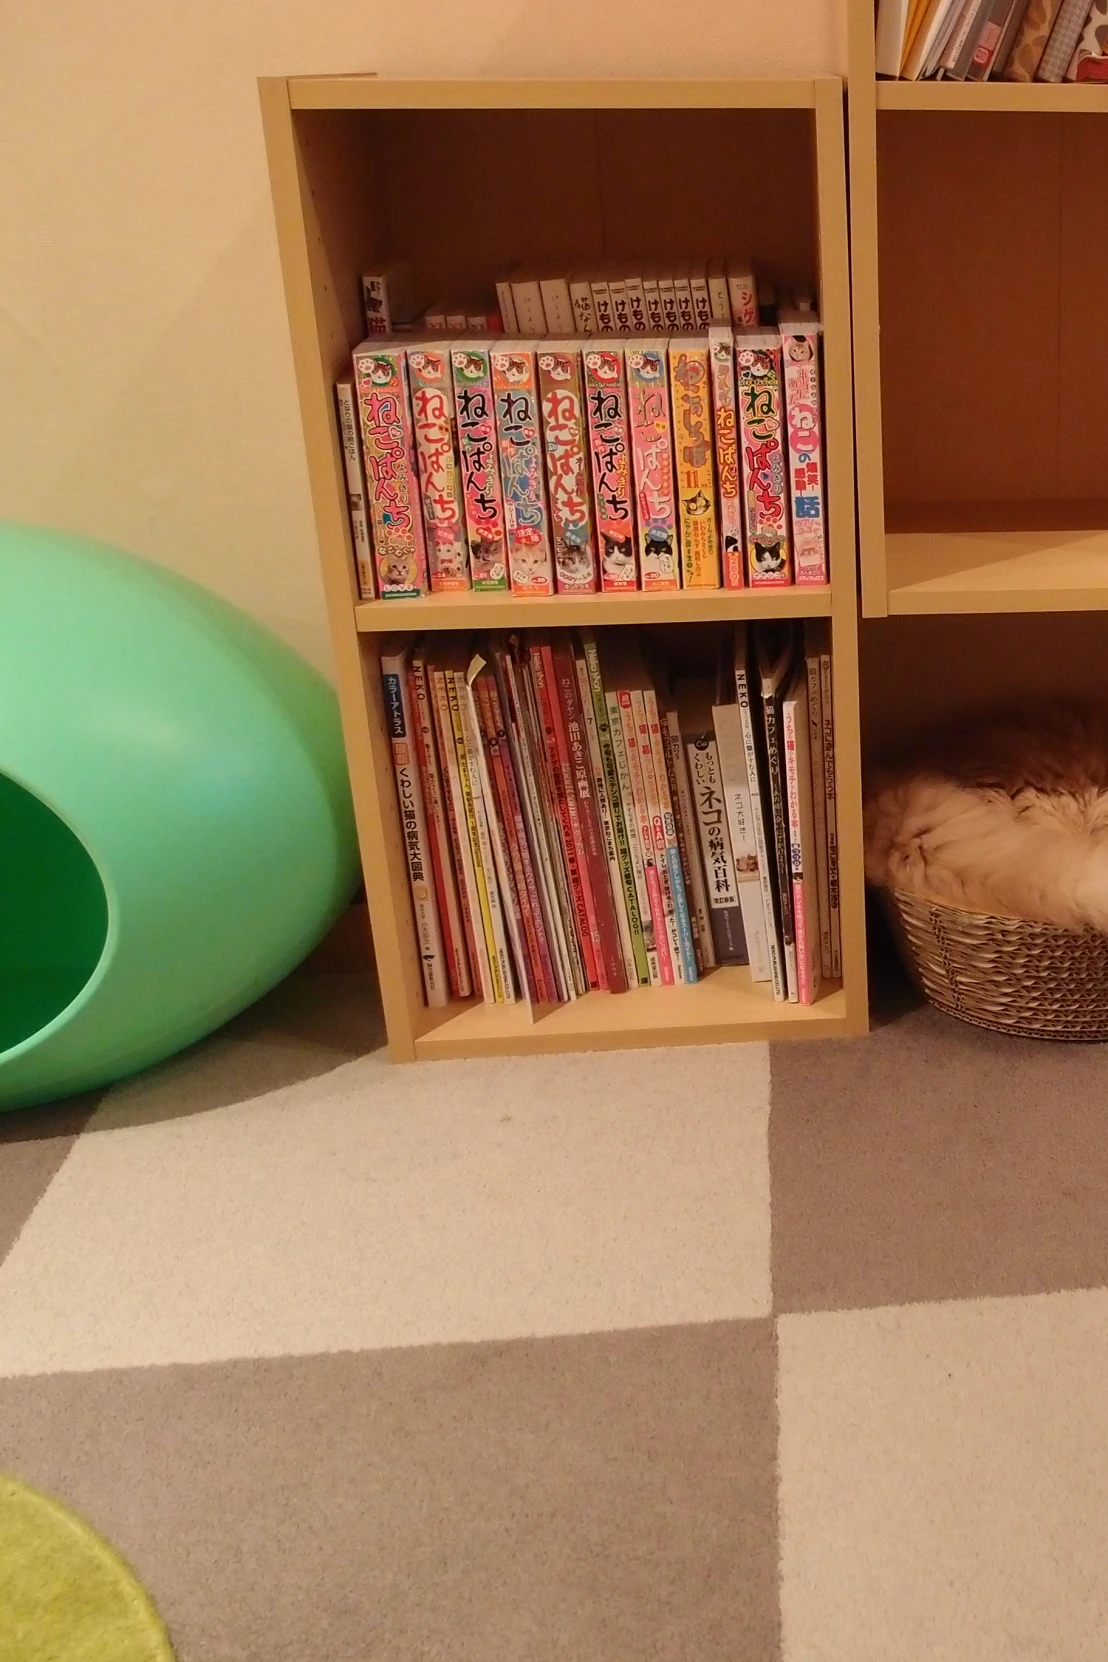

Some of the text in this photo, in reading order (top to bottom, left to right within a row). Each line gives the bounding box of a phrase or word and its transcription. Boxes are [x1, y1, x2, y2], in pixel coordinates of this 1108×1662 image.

[364, 392, 412, 530] ねこぱんち
[414, 389, 459, 524] ねこぱんち
[456, 389, 497, 520] ねこぱんち
[500, 392, 543, 526] ねこぱんち
[546, 390, 587, 524] ねこぱんち
[590, 390, 629, 521] ねこぱんち
[634, 389, 672, 519] ねこぱんち
[744, 386, 782, 520] ねこぱんち
[792, 407, 817, 452] ねこ
[794, 496, 820, 519] 話
[413, 665, 426, 701] NEKO
[436, 677, 448, 712] NEKO
[447, 677, 459, 712] NEKO
[588, 649, 598, 673] Neko
[736, 673, 749, 708] NEKO
[387, 676, 404, 734] カラーアトラス
[765, 705, 779, 775] 猫カフェめぐり
[568, 721, 591, 798] 池田あきこ原画展
[694, 752, 706, 785] くわしい
[705, 751, 716, 784] もっとも
[399, 767, 425, 882] くわしい猫の病気大図典
[700, 786, 731, 893] ネコの病気百科
